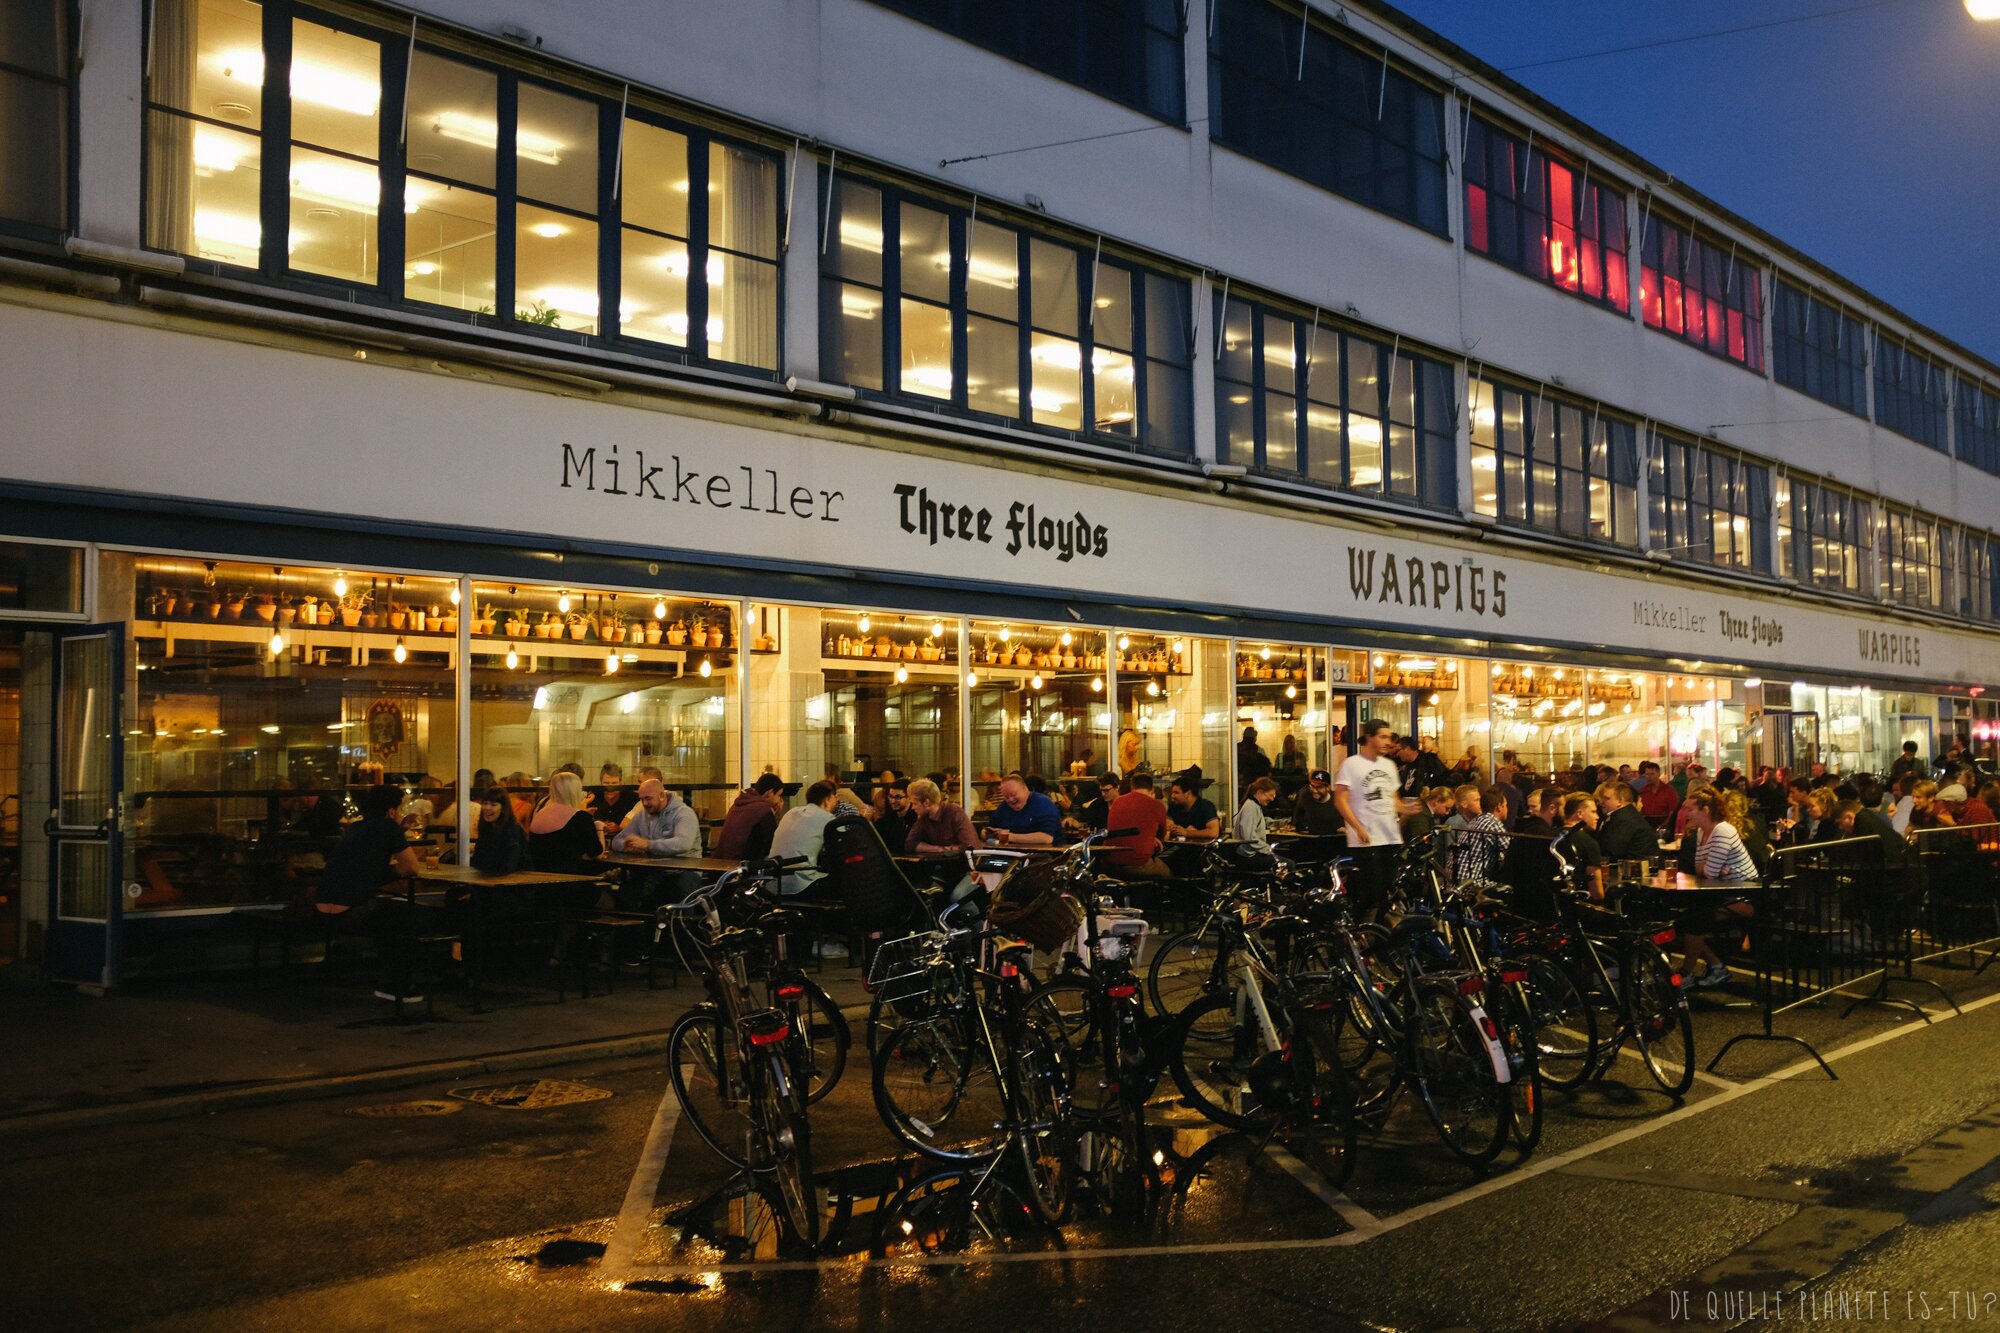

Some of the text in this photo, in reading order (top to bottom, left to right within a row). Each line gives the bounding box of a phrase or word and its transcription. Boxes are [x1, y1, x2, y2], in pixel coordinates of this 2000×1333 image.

[561, 443, 844, 522] Mikkeller
[893, 483, 1109, 563] Three Floyds
[1347, 546, 1507, 618] WARPIGS
[1633, 601, 1706, 633] Mikkeller
[1719, 610, 1748, 641] Three
[1858, 628, 1920, 667] WARPIGS
